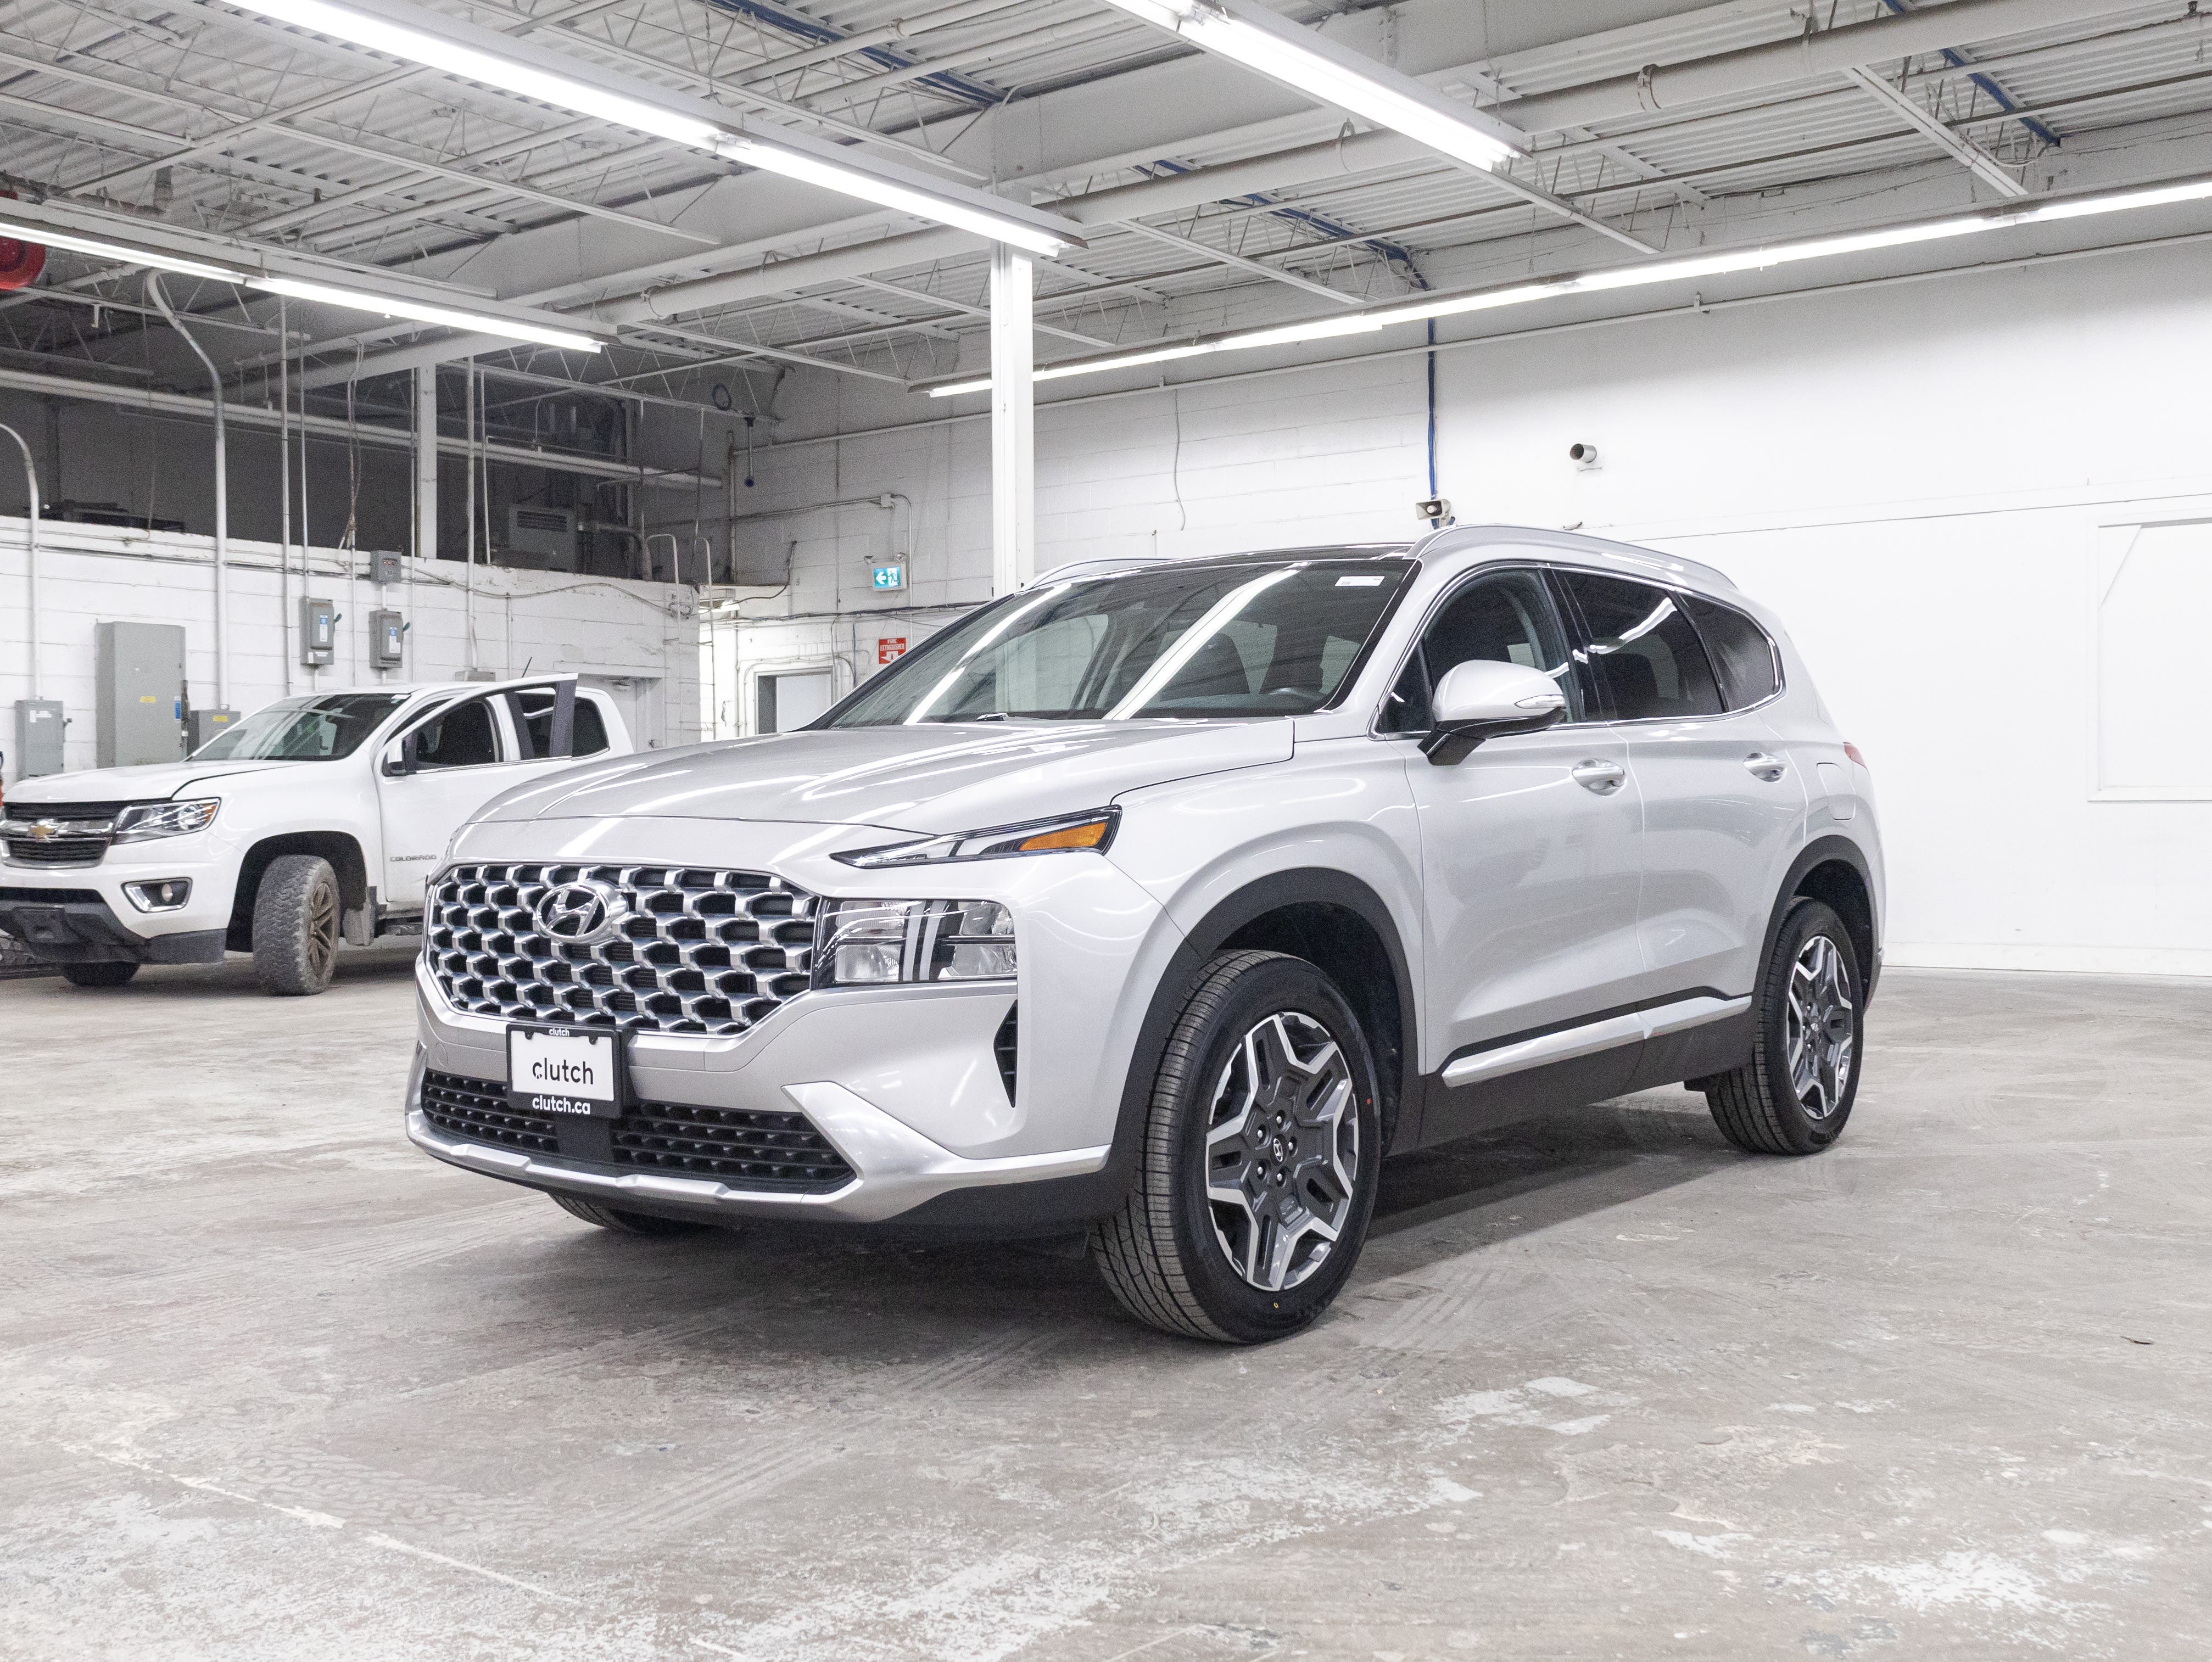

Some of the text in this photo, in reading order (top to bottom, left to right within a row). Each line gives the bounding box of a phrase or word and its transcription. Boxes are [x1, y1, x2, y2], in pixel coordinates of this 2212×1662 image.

[549, 1028, 569, 1037] clutch
[532, 1057, 594, 1085] clutch
[532, 1095, 591, 1115] clutch.ca
